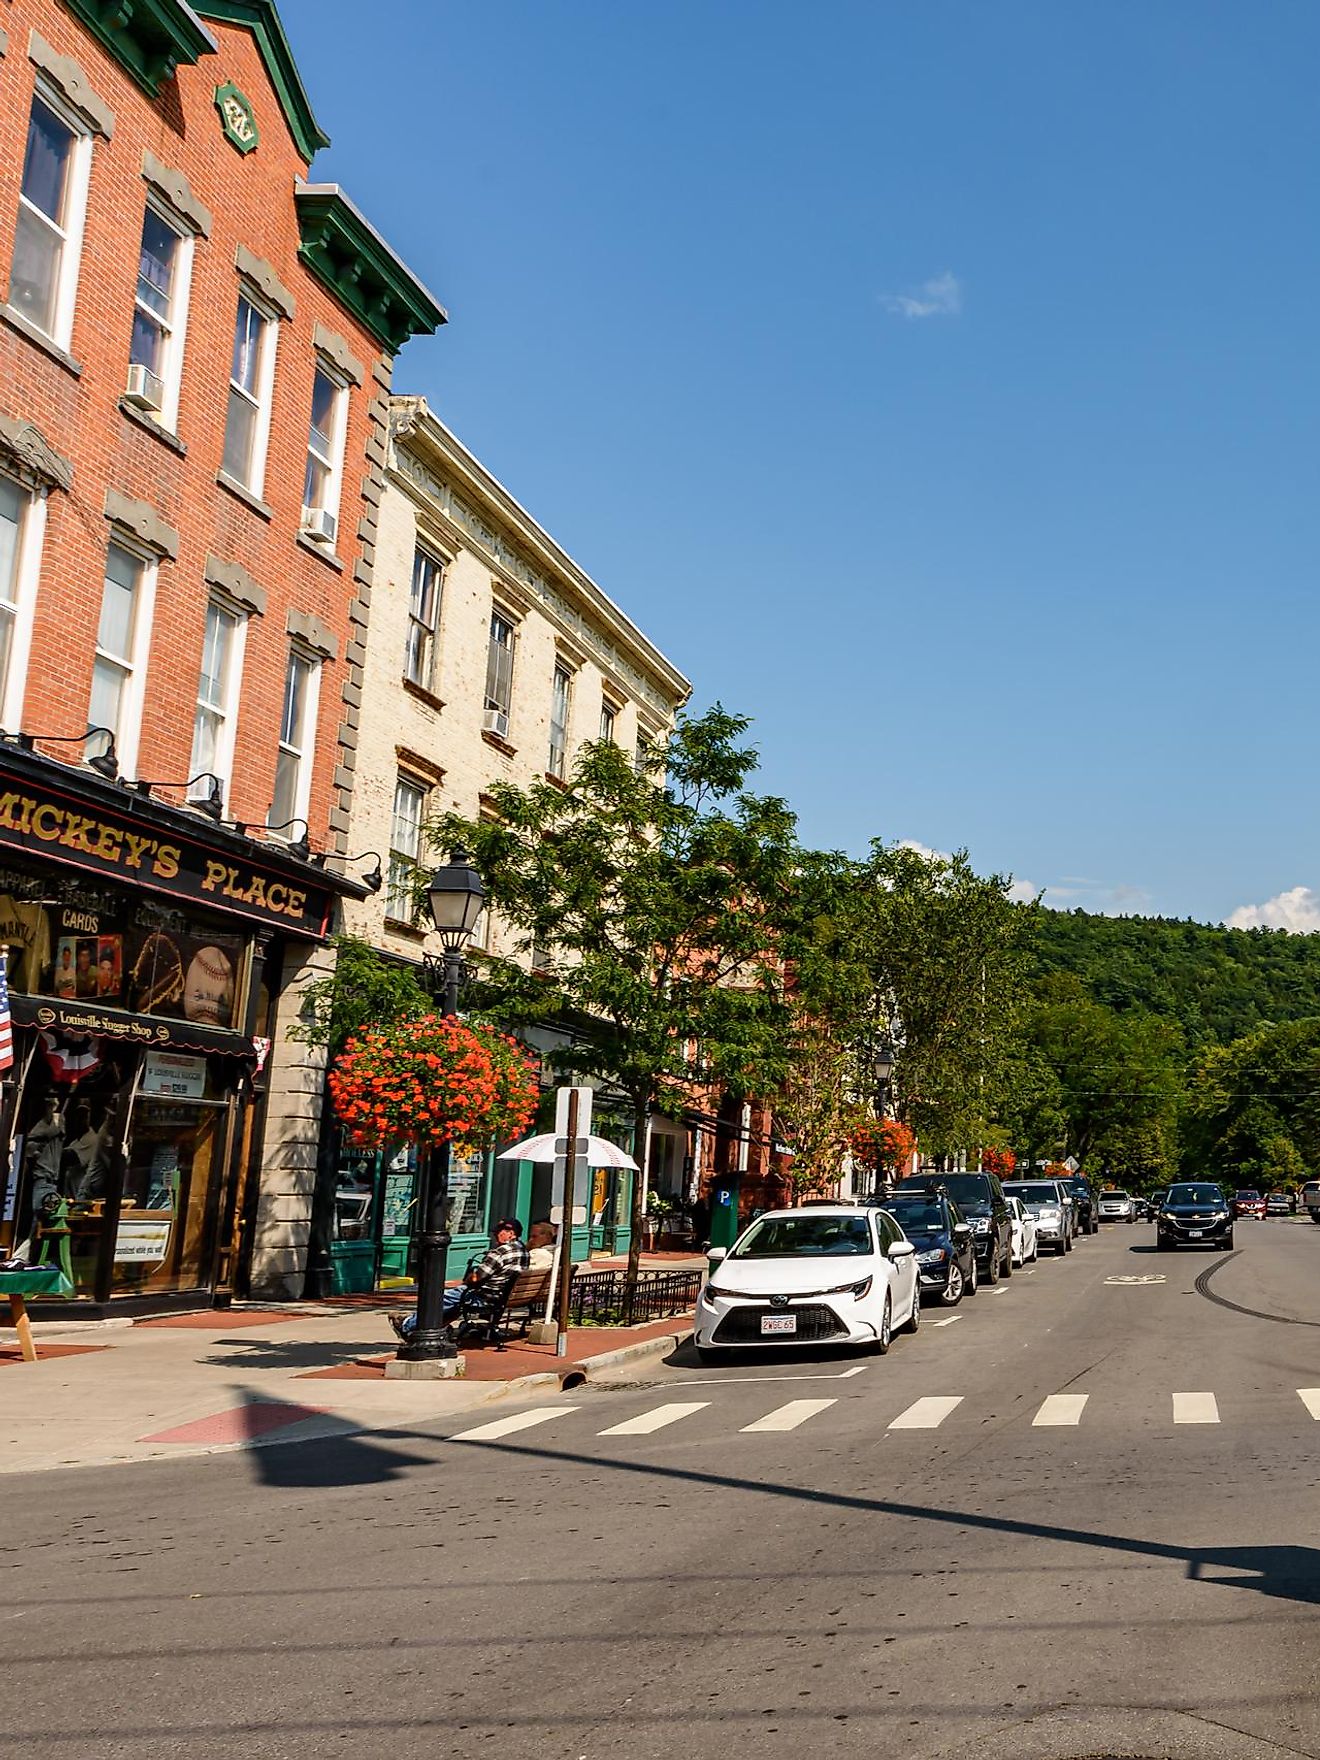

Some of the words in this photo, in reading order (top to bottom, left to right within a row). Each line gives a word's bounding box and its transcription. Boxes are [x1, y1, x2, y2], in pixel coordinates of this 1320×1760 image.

[200, 859, 307, 920] PLACE
[62, 908, 100, 934] CARDS
[59, 1010, 102, 1029] Louisville
[131, 1022, 152, 1039] Shop
[720, 1190, 730, 1204] P
